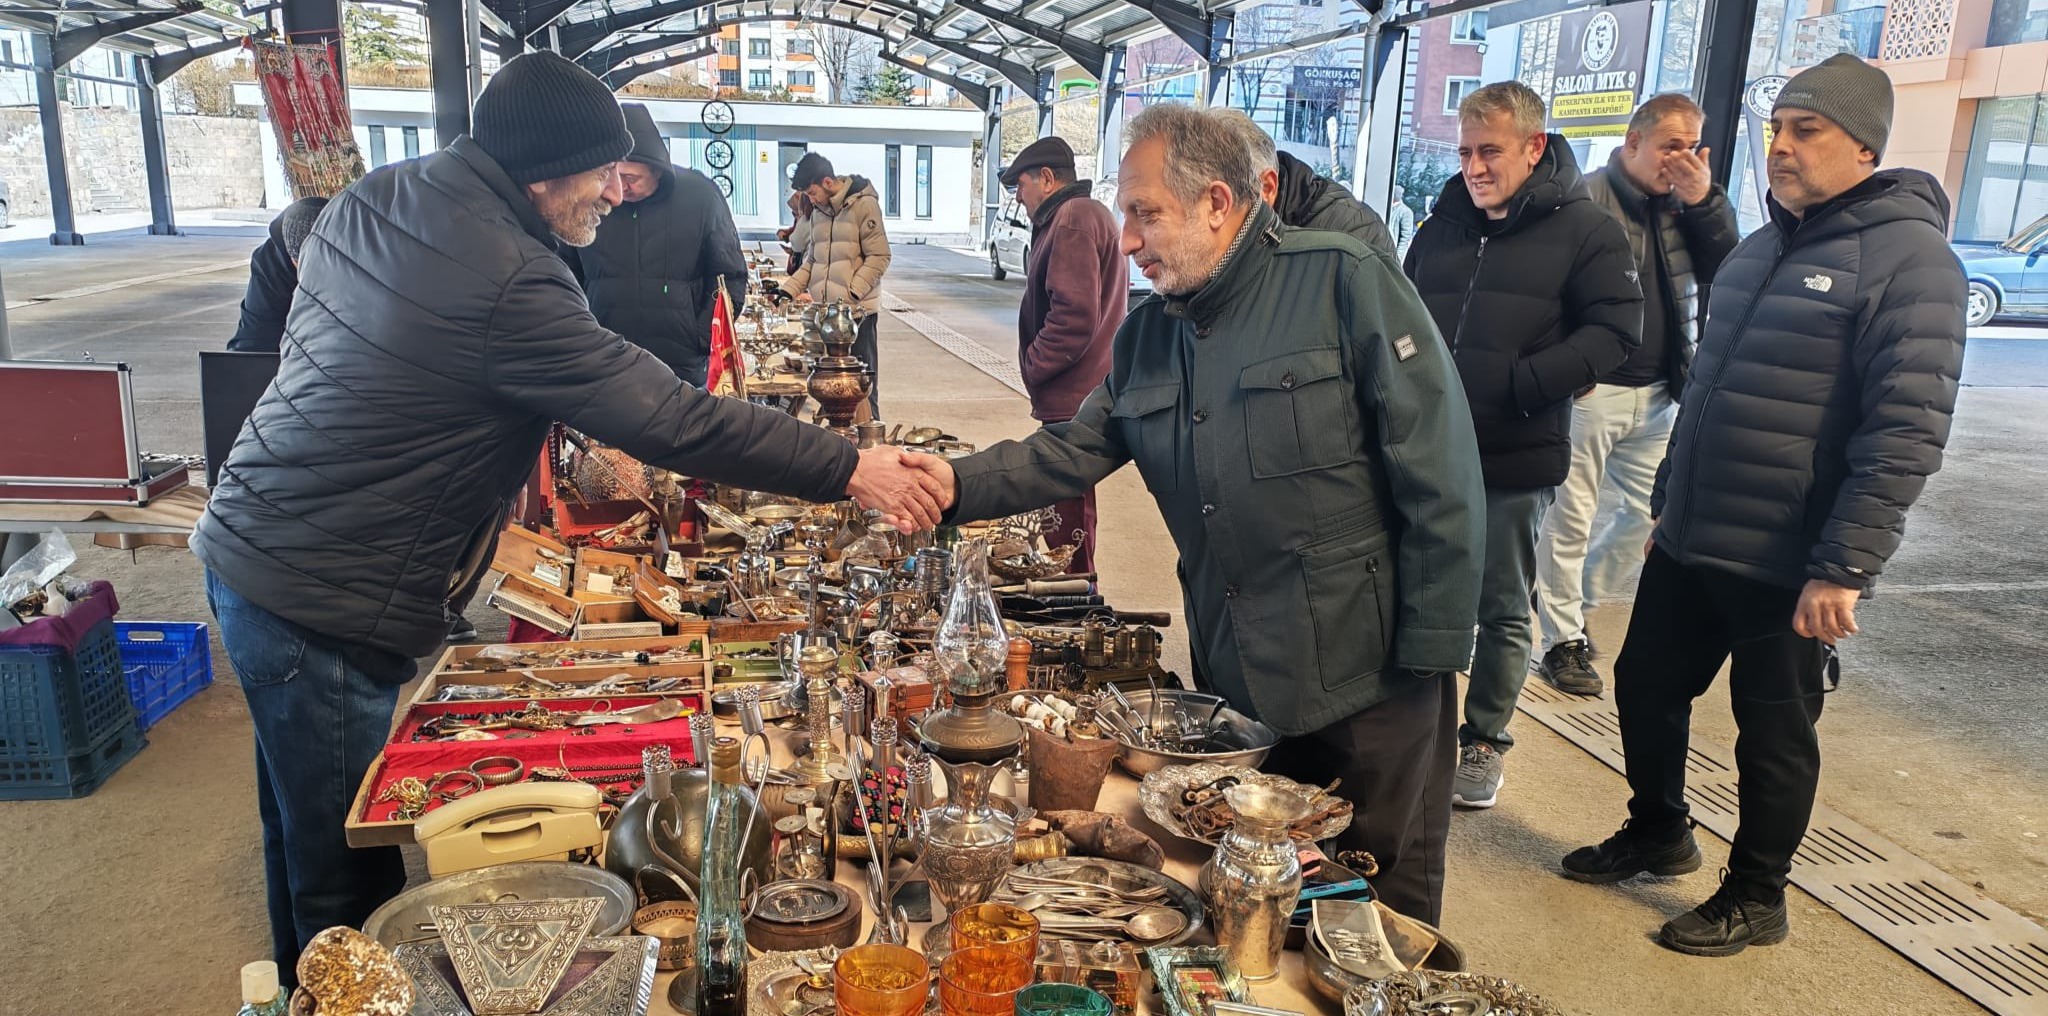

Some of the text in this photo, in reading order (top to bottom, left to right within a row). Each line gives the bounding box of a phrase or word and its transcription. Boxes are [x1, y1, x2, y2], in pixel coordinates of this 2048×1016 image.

[1555, 71, 1636, 94] SALON MYK 9
[1607, 95, 1616, 103] VE
[1617, 94, 1632, 102] TEK
[1558, 107, 1591, 116] KAMPANYA
